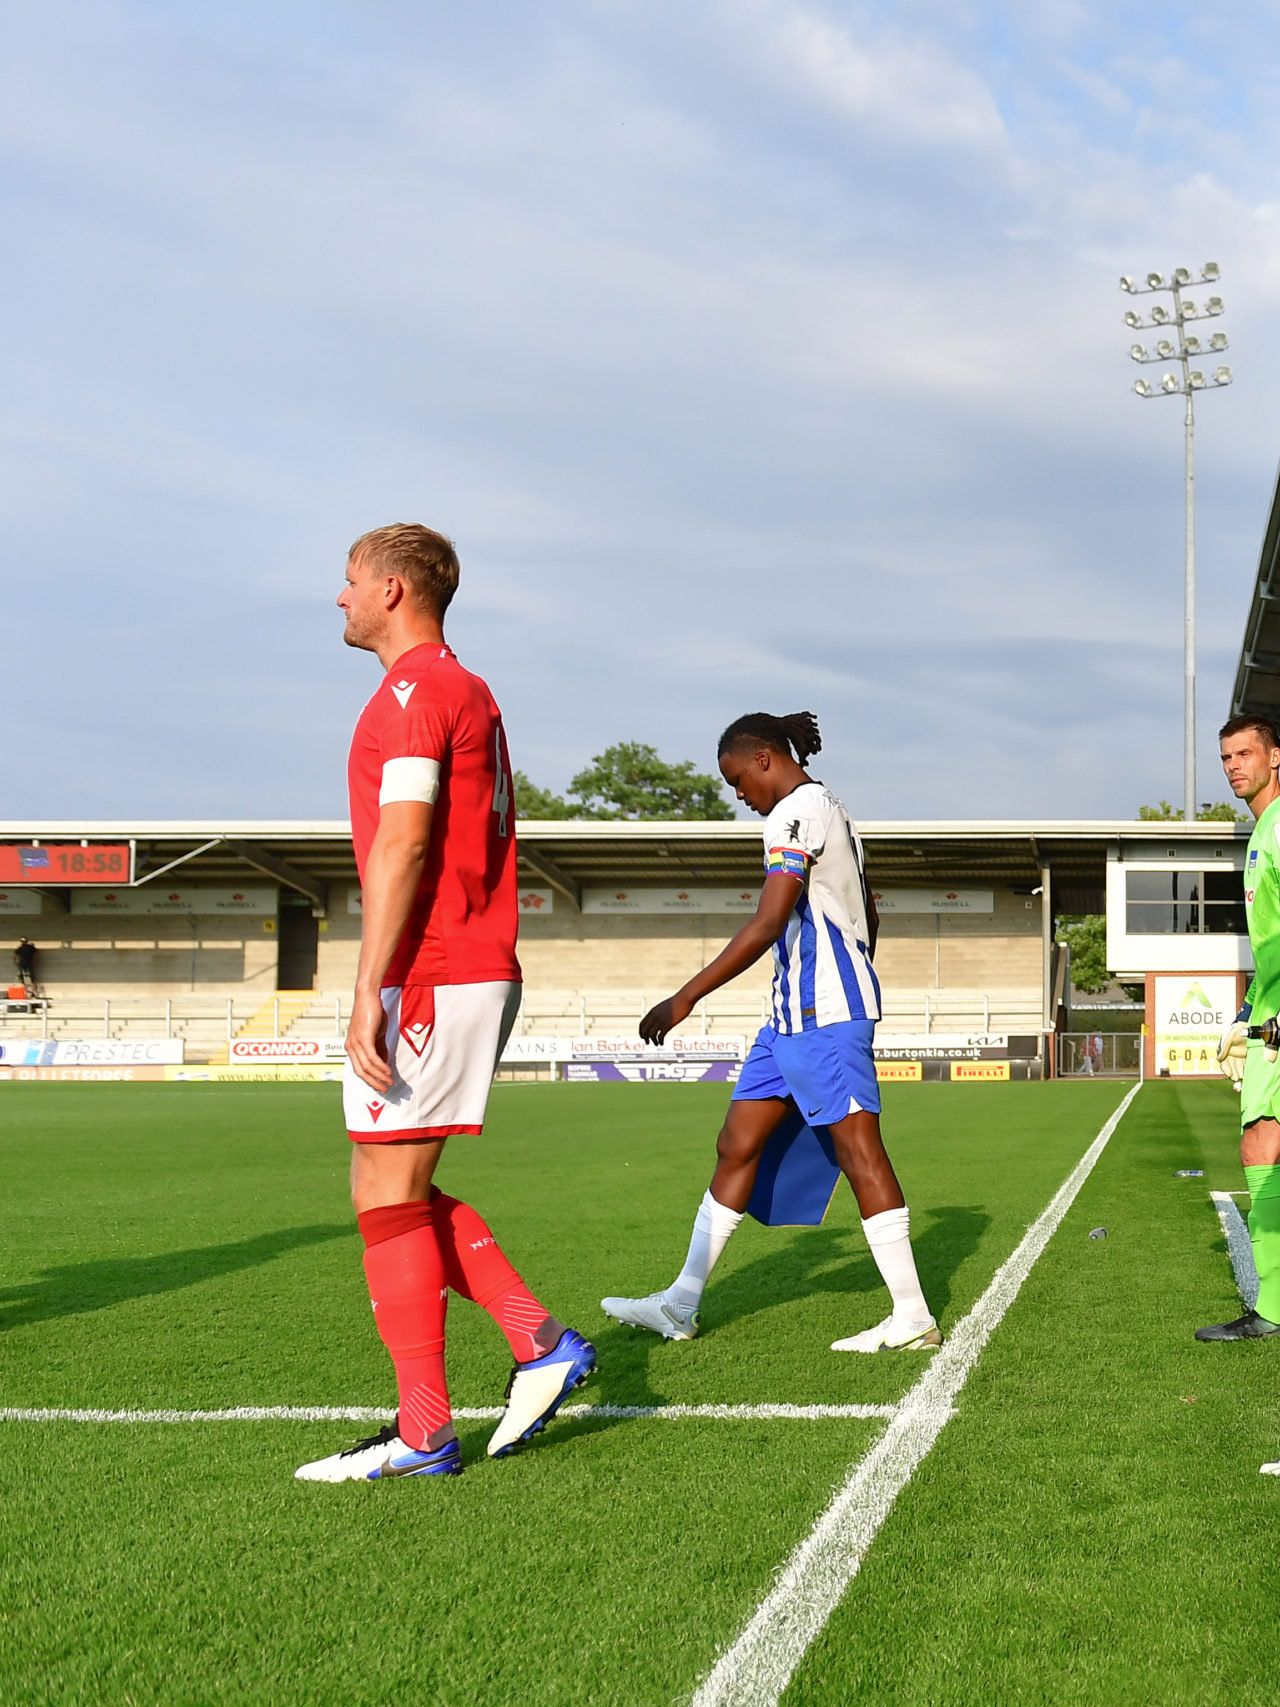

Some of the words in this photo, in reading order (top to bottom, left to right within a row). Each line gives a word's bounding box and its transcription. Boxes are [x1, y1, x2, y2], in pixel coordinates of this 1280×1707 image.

[57, 852, 123, 873] 18:58
[1168, 1011, 1223, 1025] ABODE
[571, 1039, 593, 1052] Ian
[597, 1039, 646, 1052] Barker
[673, 1039, 740, 1051] Butchers
[968, 1036, 1003, 1046] KIA
[64, 1043, 161, 1061] PRESTEC
[1169, 1049, 1208, 1061] GOA
[956, 1066, 1004, 1077] PIRELLI
